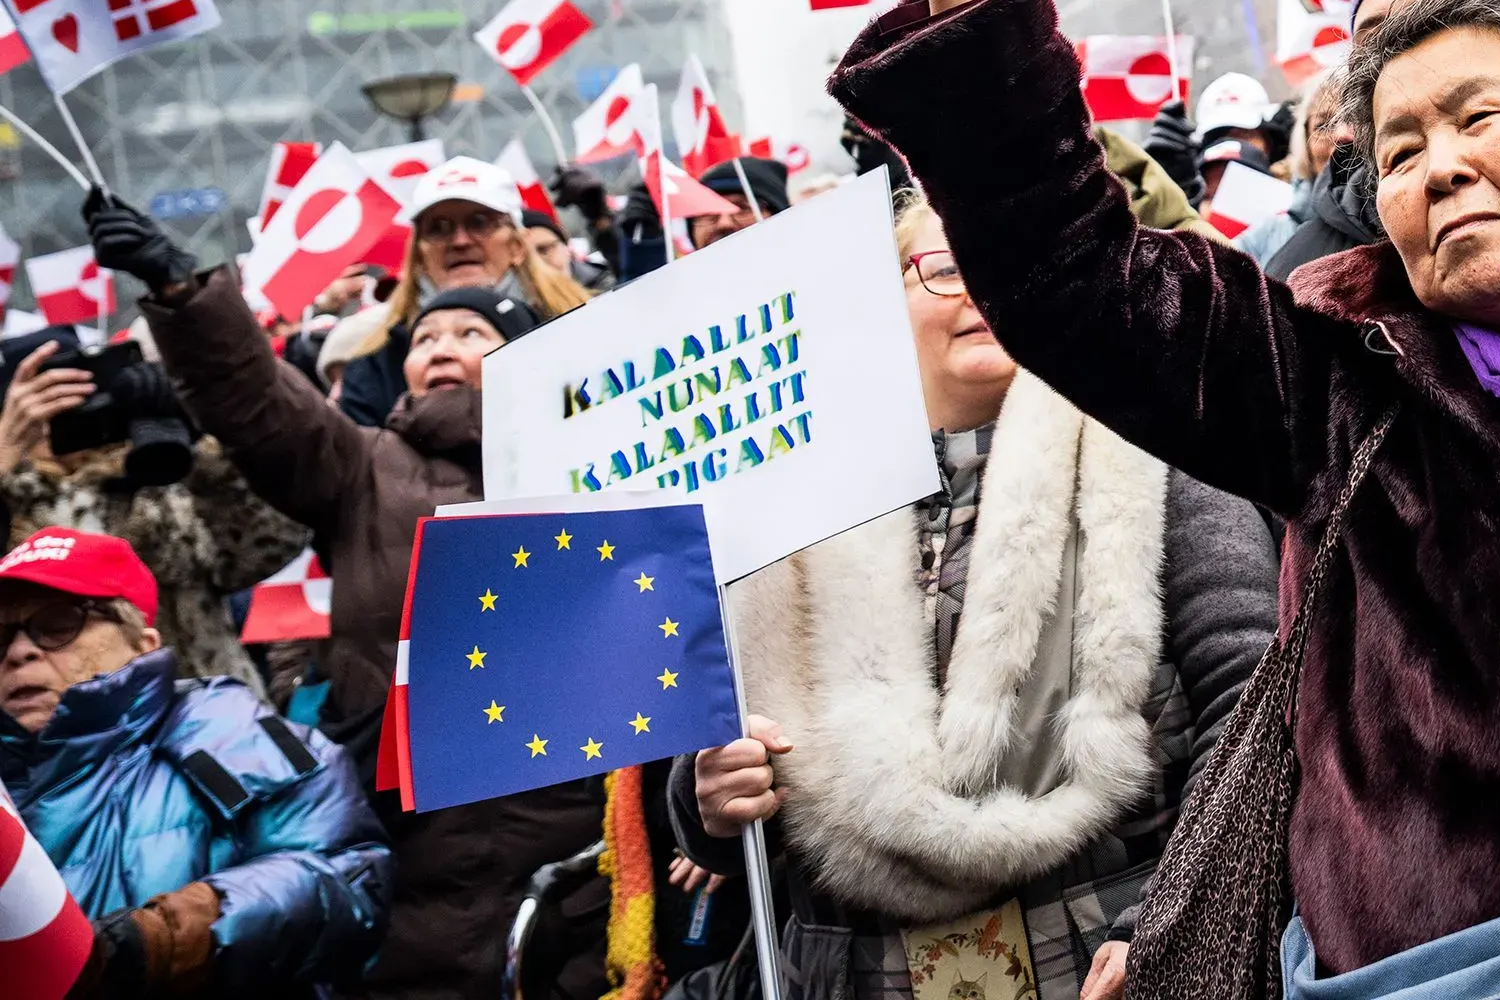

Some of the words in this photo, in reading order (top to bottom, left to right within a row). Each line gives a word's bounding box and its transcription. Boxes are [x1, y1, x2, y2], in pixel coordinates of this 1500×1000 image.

[563, 290, 796, 419] KALAALLIT
[638, 330, 801, 427] NUNAAT
[570, 370, 807, 493] KALAALLIT
